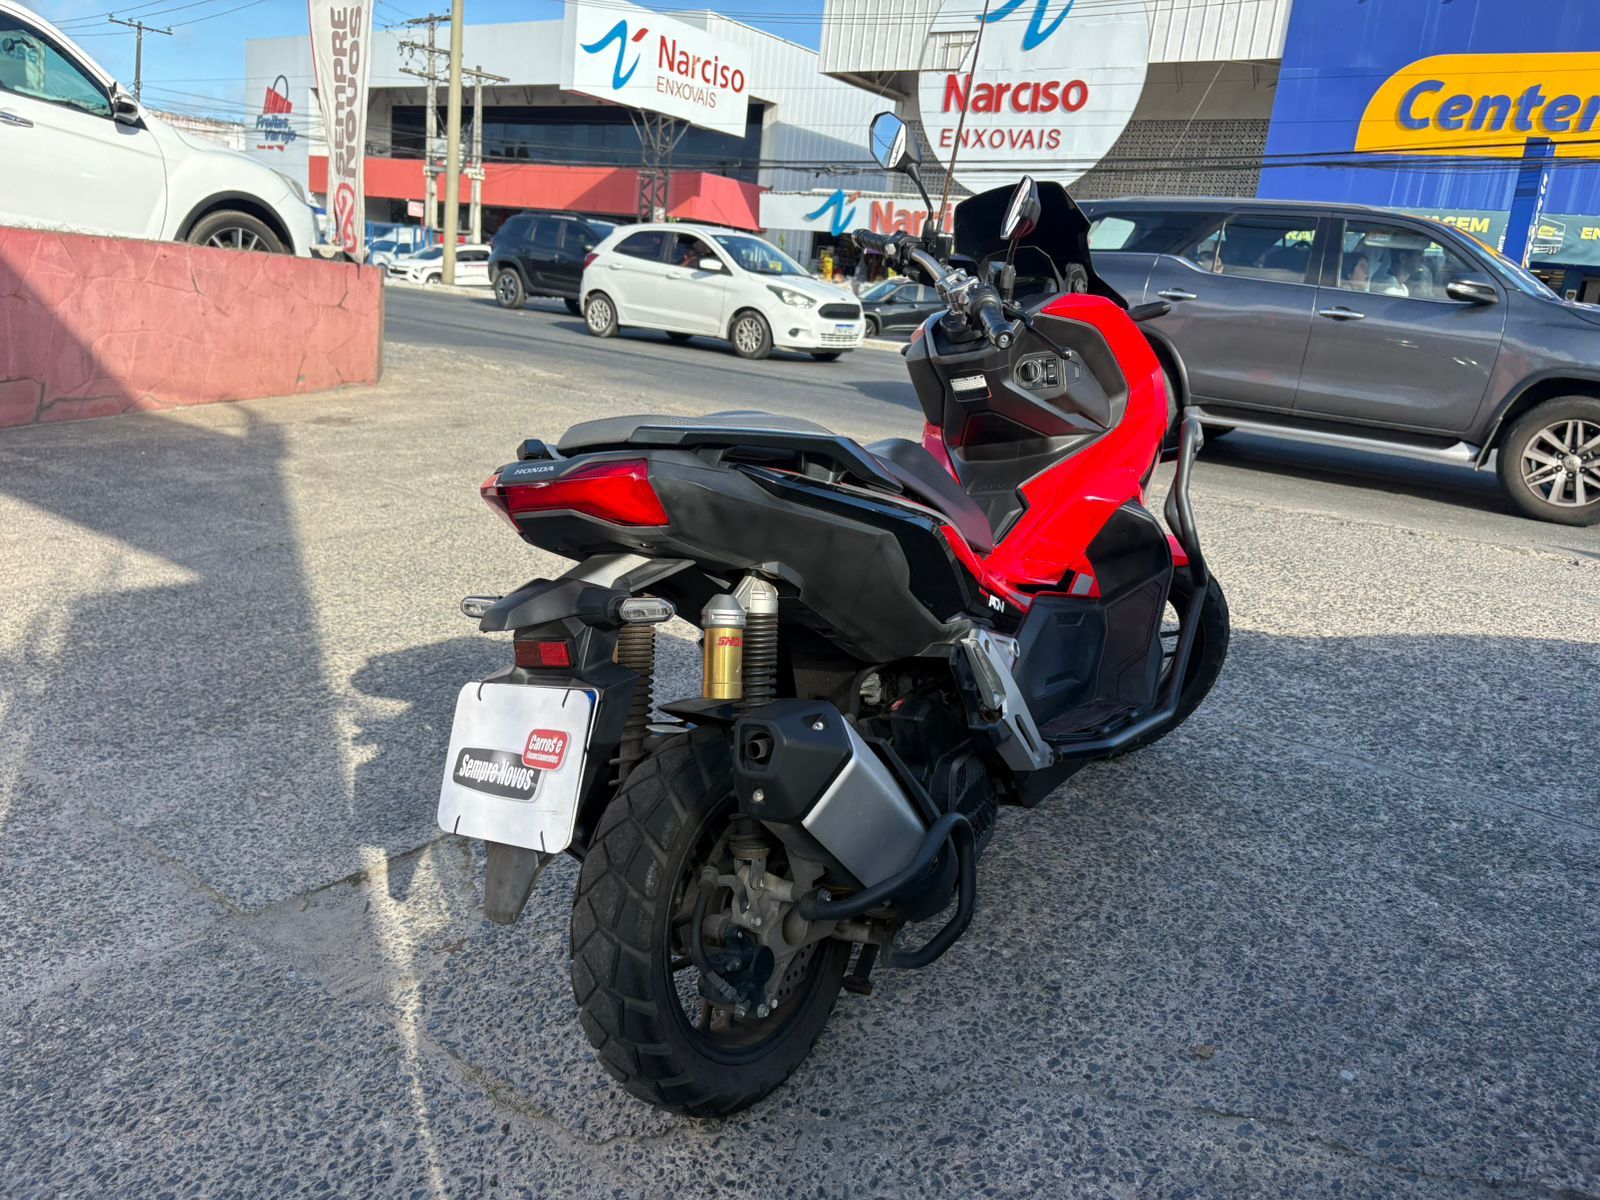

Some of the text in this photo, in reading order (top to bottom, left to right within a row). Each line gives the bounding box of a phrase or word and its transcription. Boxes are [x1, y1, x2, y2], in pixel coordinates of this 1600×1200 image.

[658, 34, 745, 93] Narciso
[656, 75, 717, 109] ENXOVAIS
[943, 74, 1088, 112] Narciso
[1396, 79, 1600, 132] Center
[939, 128, 1062, 149] ENXOVAIS
[513, 465, 554, 475] HONDA
[529, 734, 563, 753] Carros e
[459, 753, 534, 791] Sempre Novos
